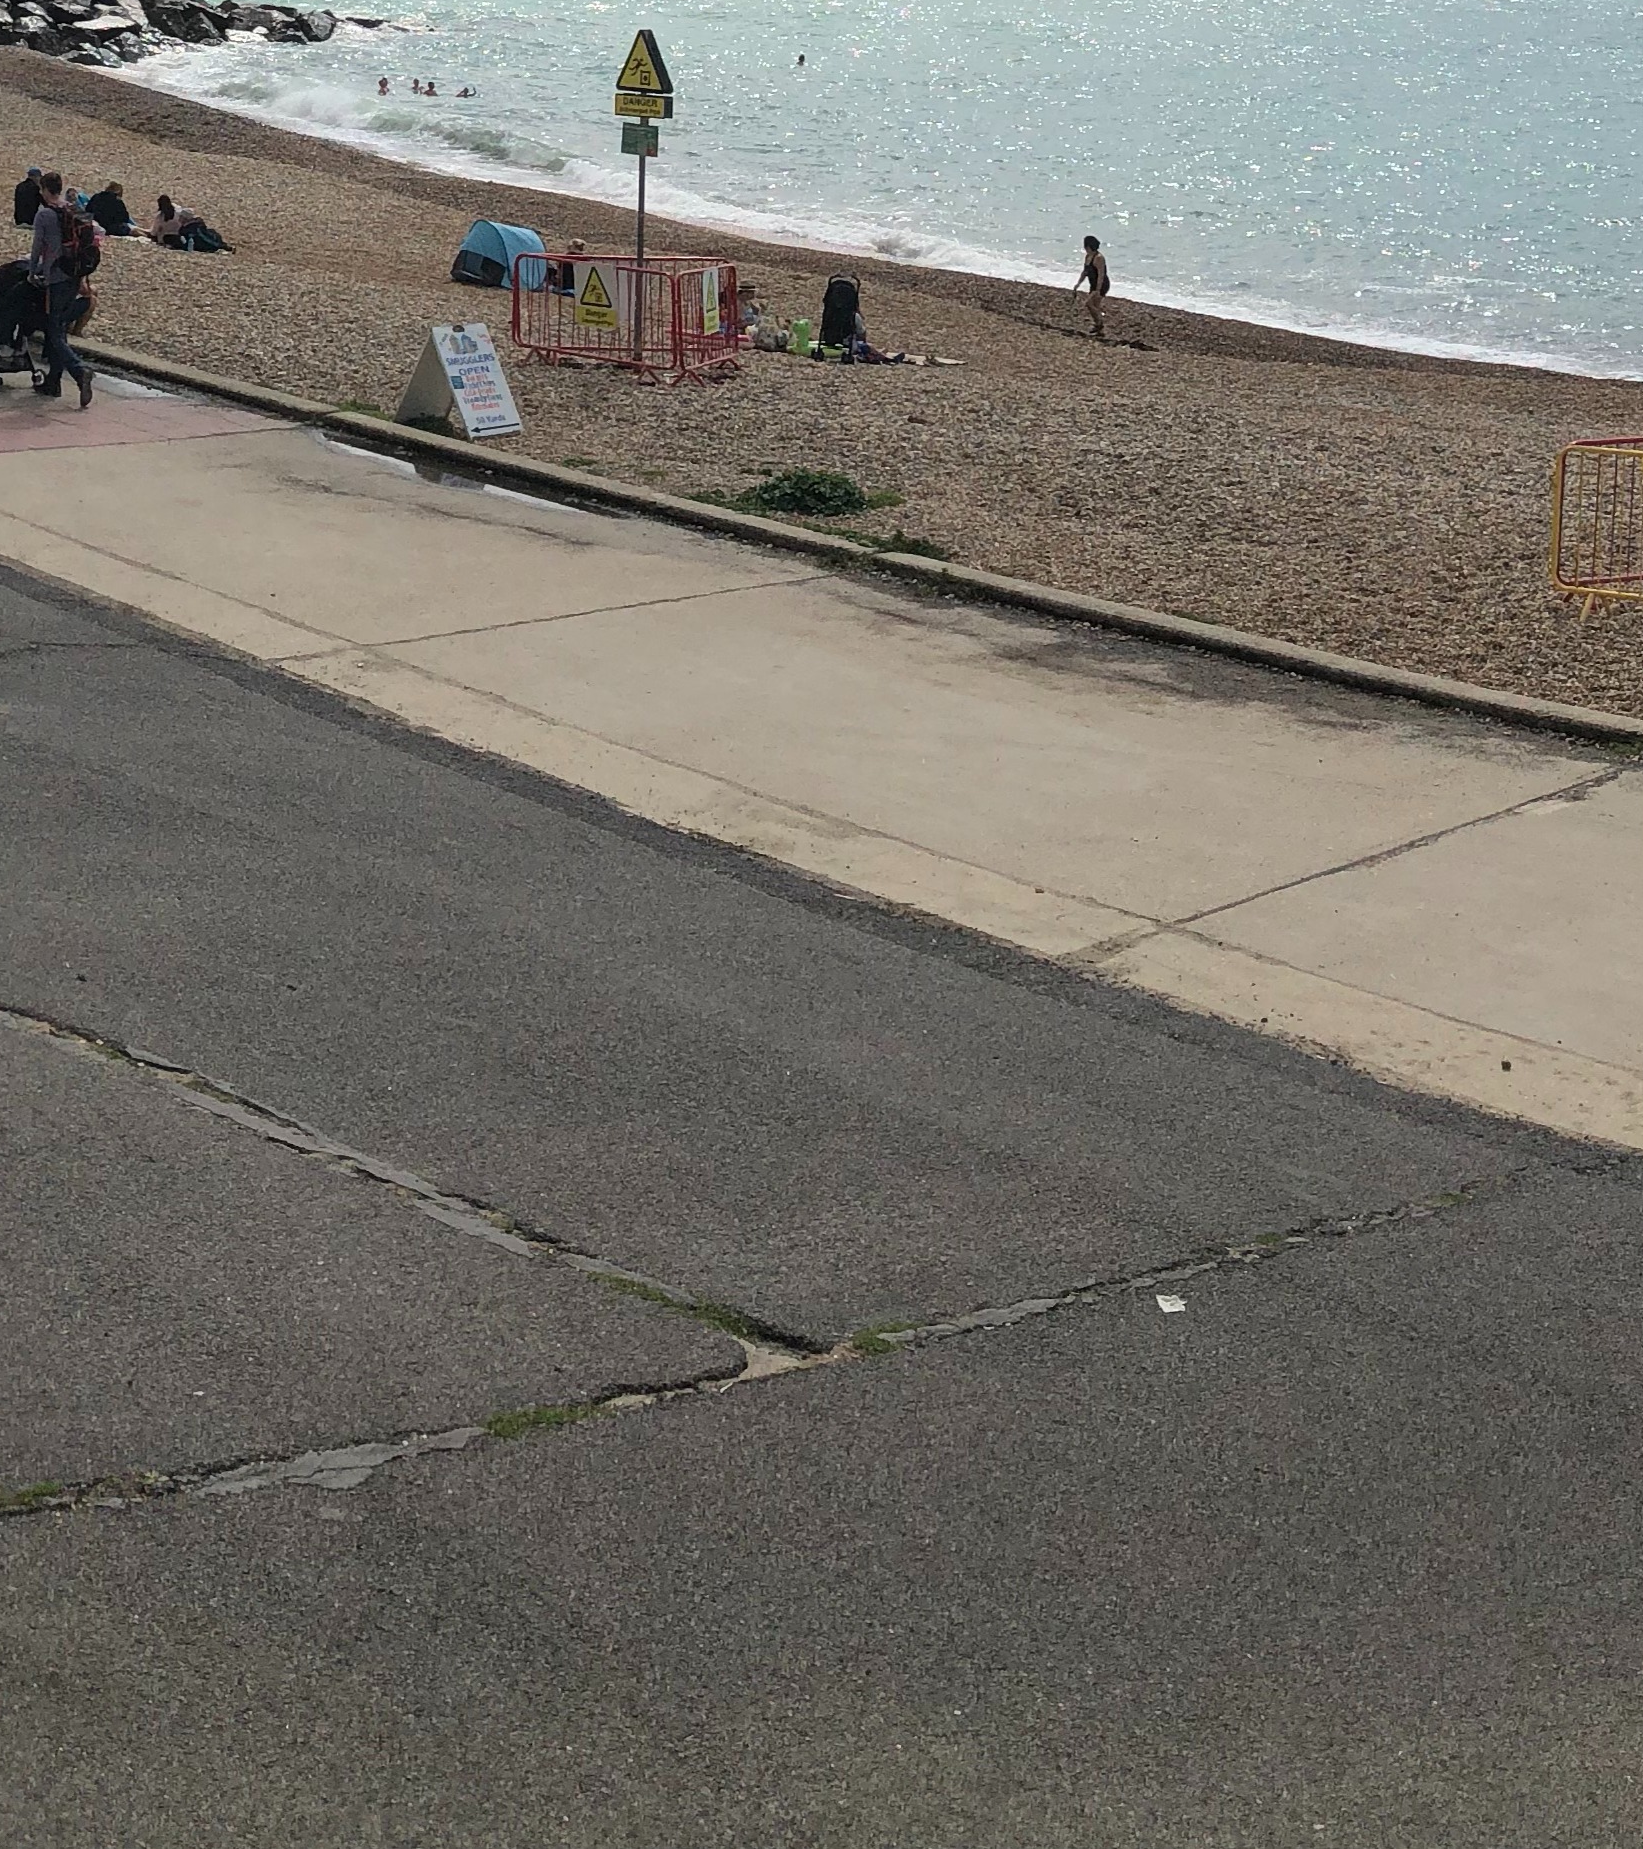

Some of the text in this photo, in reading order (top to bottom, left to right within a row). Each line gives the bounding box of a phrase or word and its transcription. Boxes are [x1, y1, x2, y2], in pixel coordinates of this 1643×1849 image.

[623, 97, 658, 108] DANGER
[446, 353, 495, 366] SMUGGLERS
[458, 365, 490, 376] OPEN
